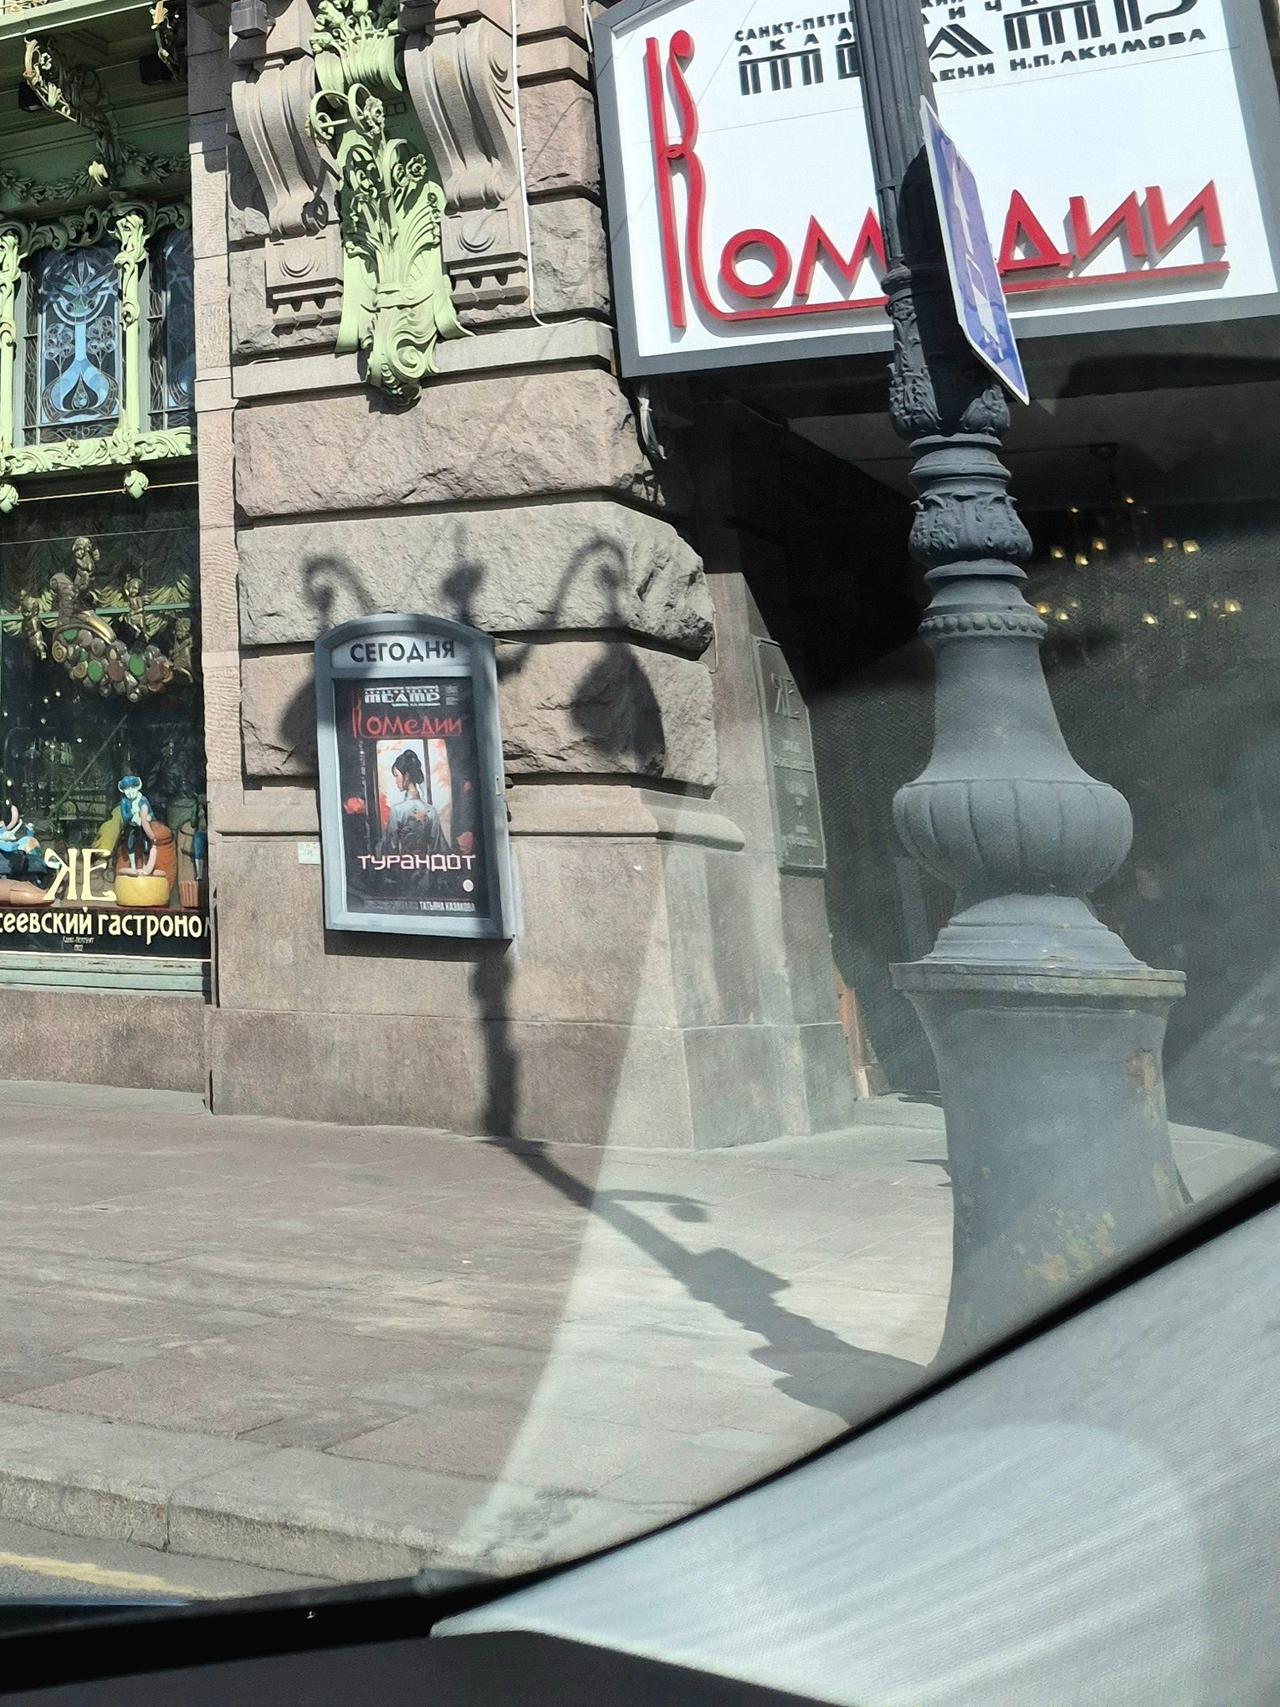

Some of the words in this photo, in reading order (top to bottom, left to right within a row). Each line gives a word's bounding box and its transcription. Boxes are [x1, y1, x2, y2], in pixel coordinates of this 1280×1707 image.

[1010, 54, 1056, 72] Н.П.
[1060, 28, 1207, 64] АКИМОВА
[350, 640, 455, 663] СЕГОДНЯ
